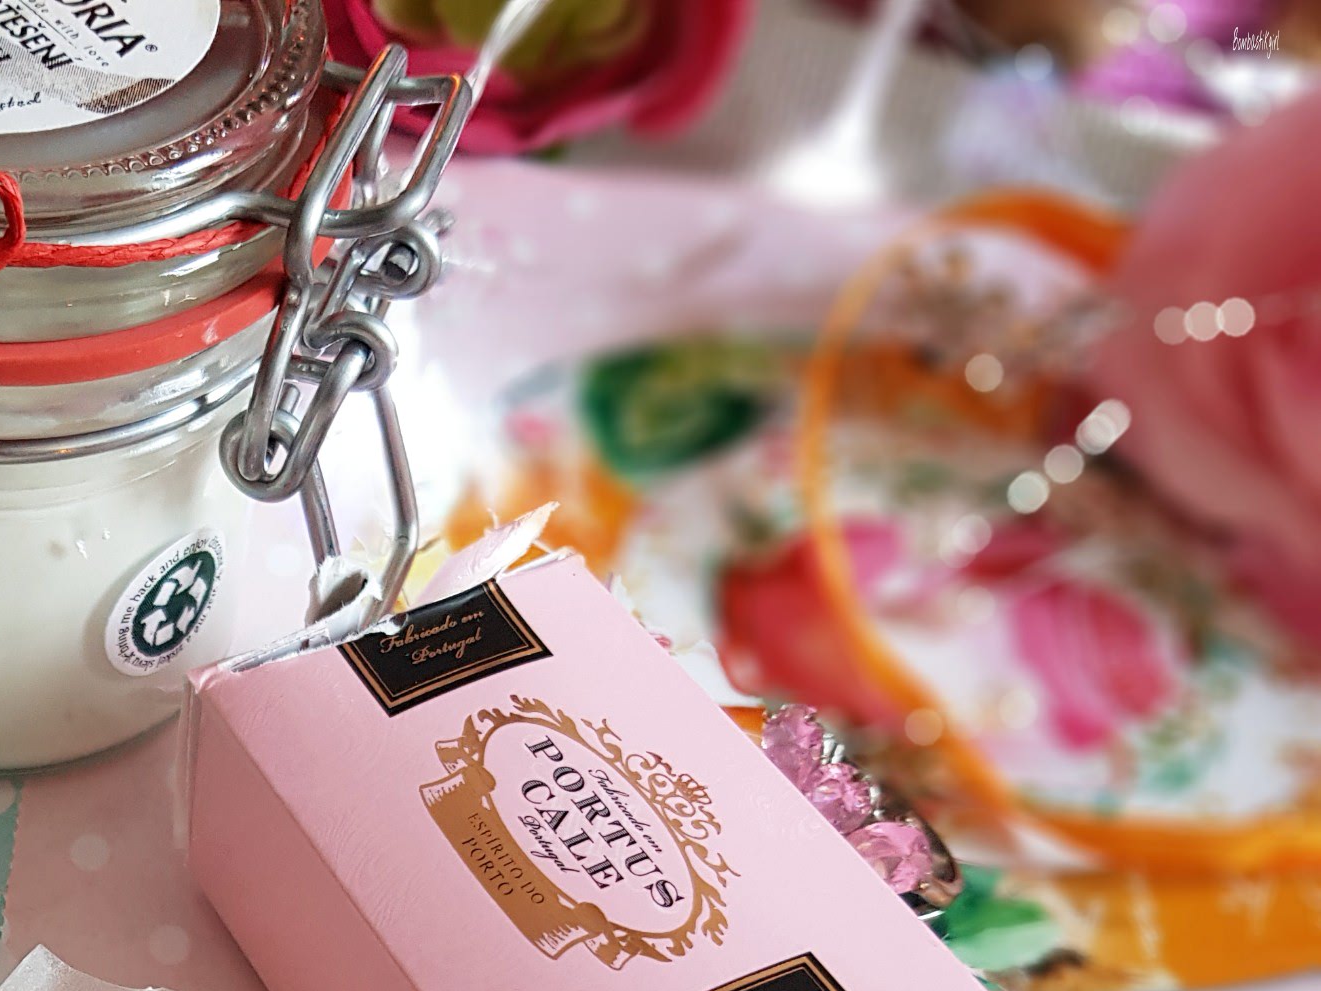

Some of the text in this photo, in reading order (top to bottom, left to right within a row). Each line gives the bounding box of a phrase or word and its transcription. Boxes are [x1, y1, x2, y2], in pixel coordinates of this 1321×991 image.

[121, 606, 134, 624] me
[130, 574, 157, 603] back
[159, 550, 179, 574] and
[379, 614, 458, 654] Fabricado
[410, 626, 482, 665] Portugal
[523, 735, 685, 909] PORTUS
[586, 768, 645, 837] Fabricado
[518, 814, 581, 875] Portugal
[520, 778, 625, 890] CALE
[461, 837, 514, 897] PORTO
[520, 881, 546, 906] DO
